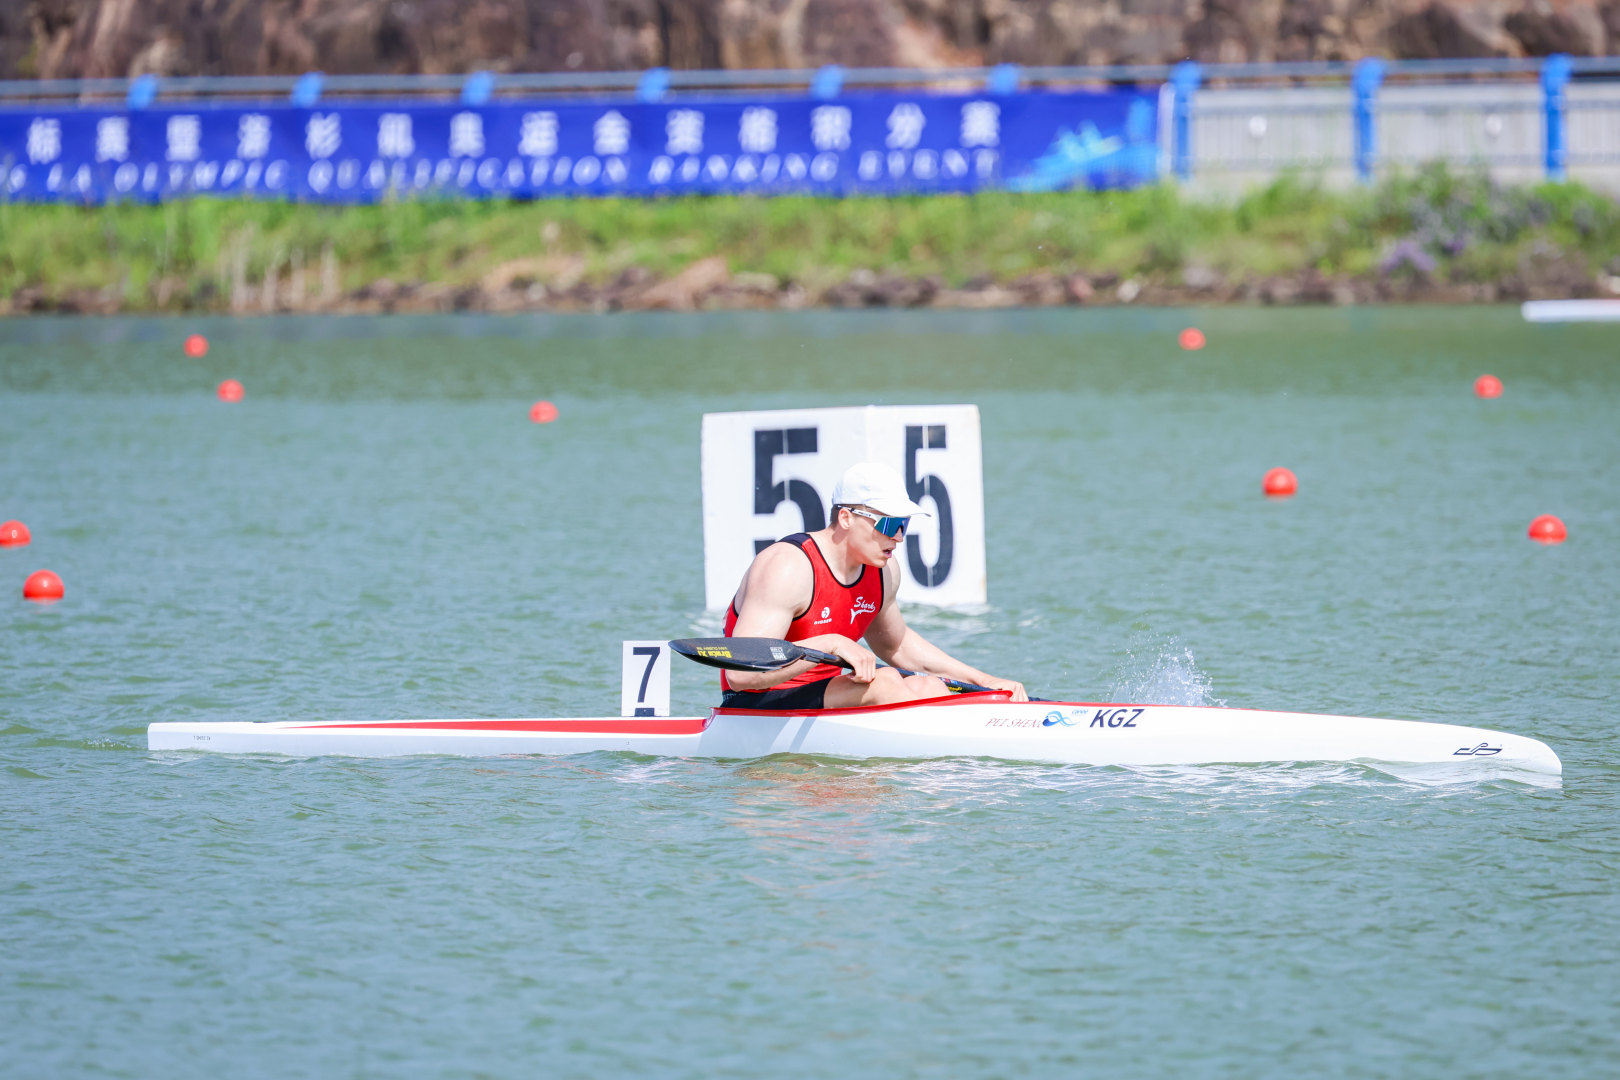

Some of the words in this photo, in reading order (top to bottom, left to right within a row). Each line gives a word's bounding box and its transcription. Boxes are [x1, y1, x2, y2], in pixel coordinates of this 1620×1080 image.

[754, 427, 826, 556] 5
[905, 425, 954, 587] 5
[633, 647, 660, 703] 7
[1089, 708, 1145, 728] KGZ
